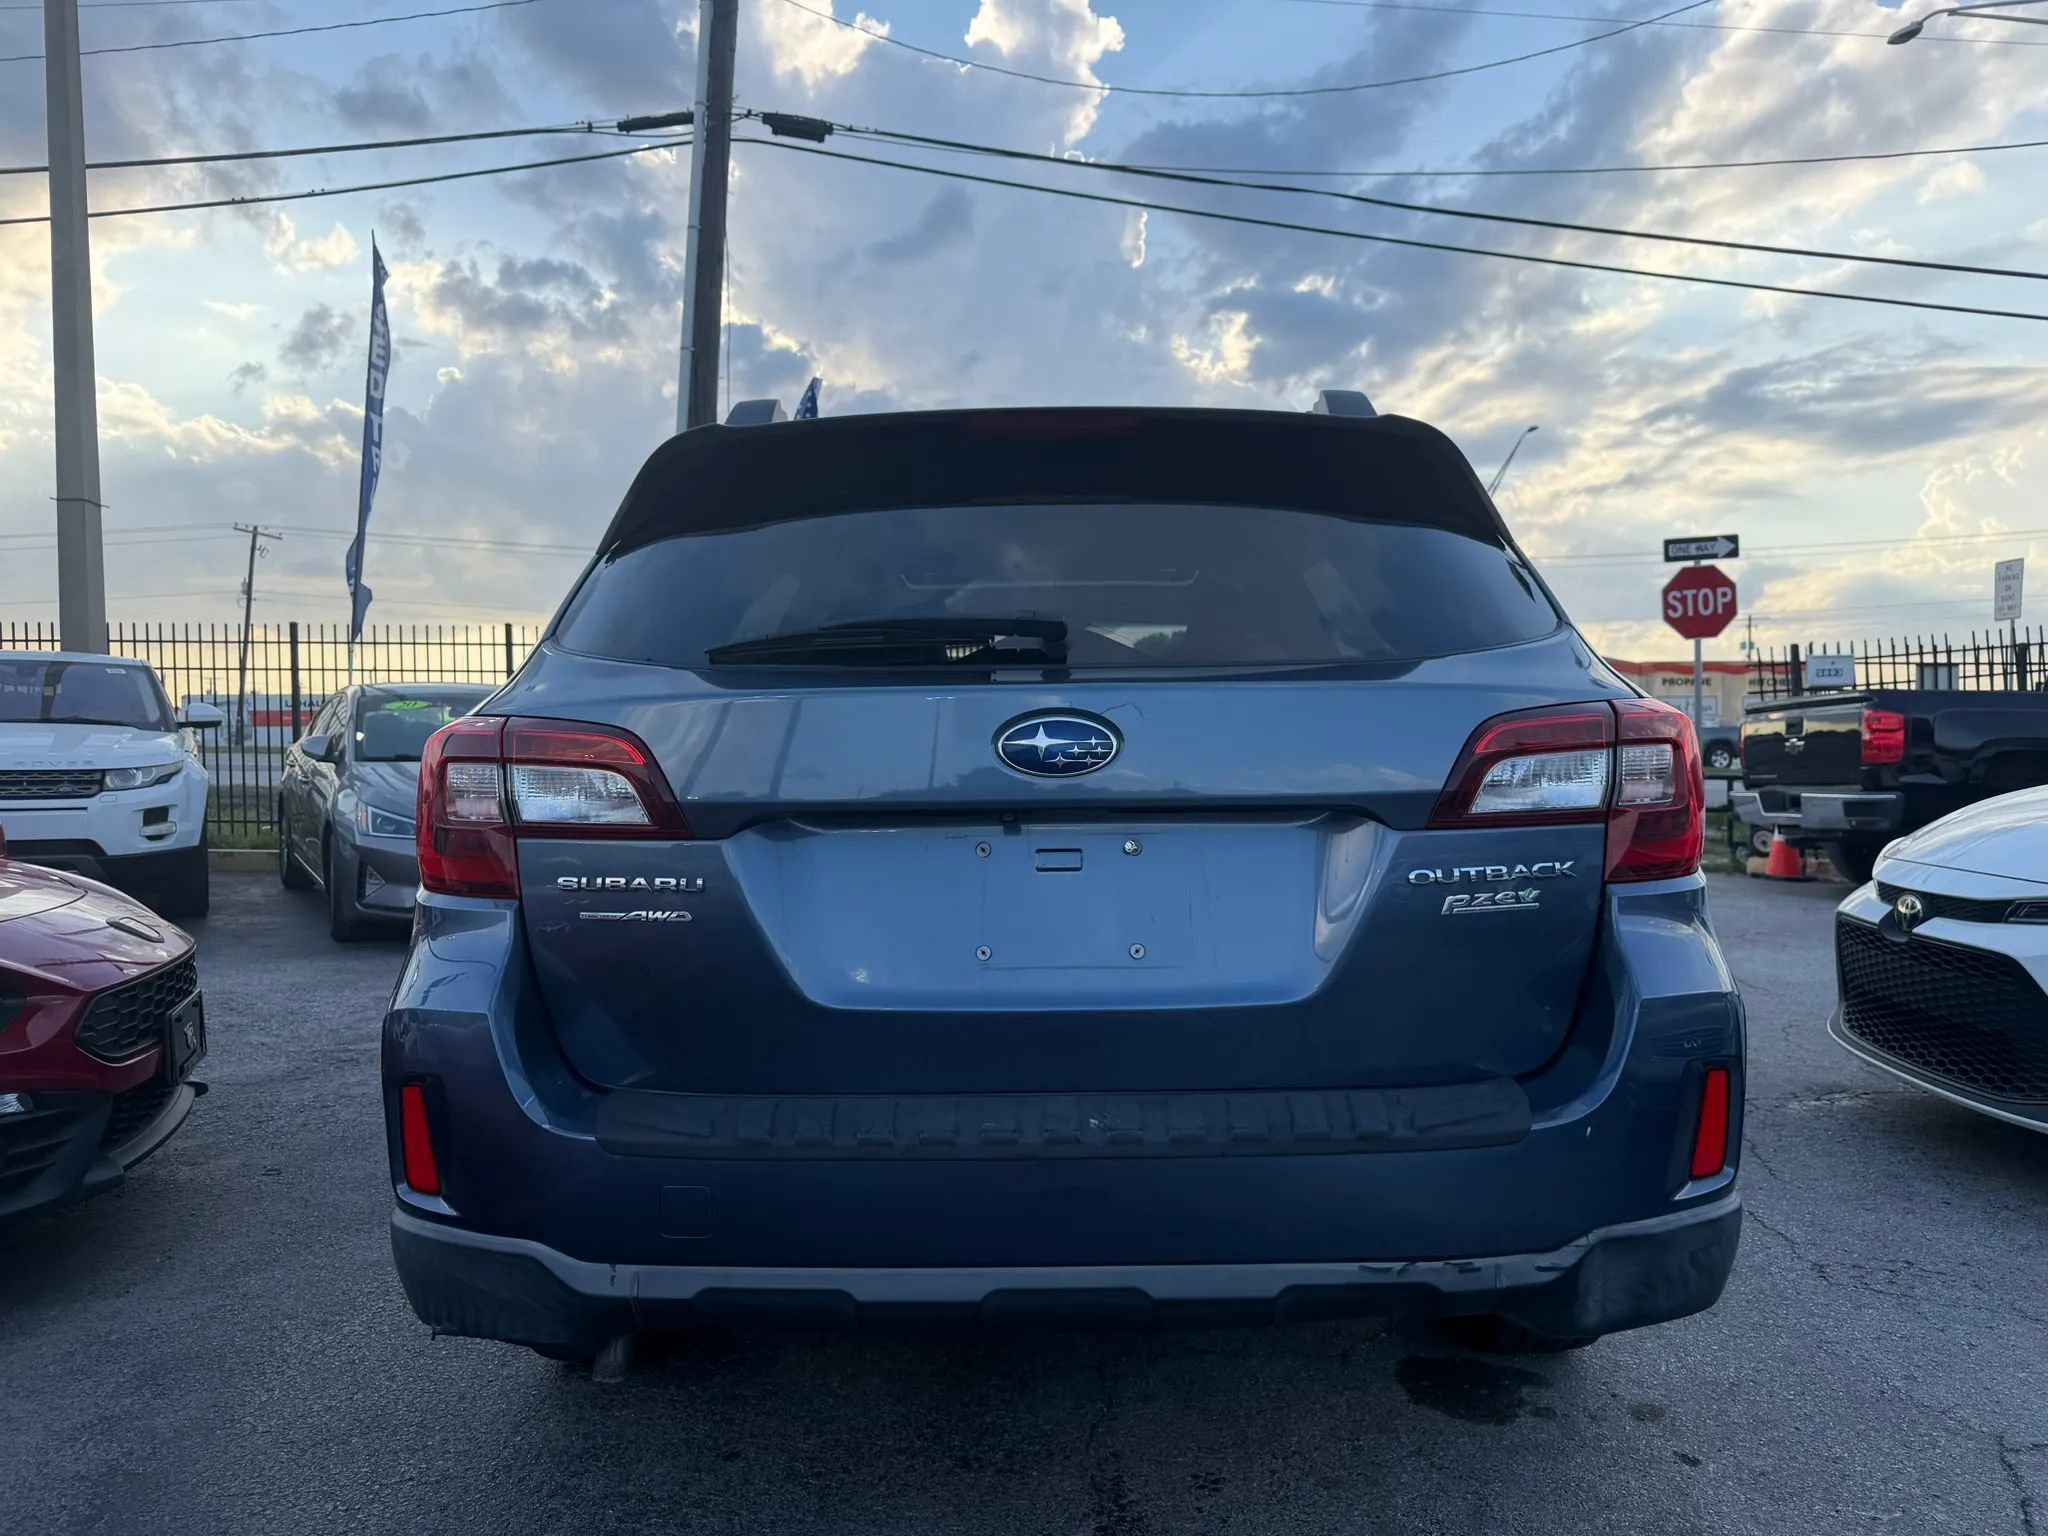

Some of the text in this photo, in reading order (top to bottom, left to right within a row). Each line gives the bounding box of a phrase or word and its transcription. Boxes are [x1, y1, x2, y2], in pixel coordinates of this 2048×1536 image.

[1671, 542, 1716, 555] ONE WAY
[1667, 586, 1733, 618] STOP
[14, 760, 95, 769] ROVER
[1408, 860, 1577, 885] OUTBACK
[557, 876, 704, 892] SUBARU
[621, 910, 693, 922] AWD
